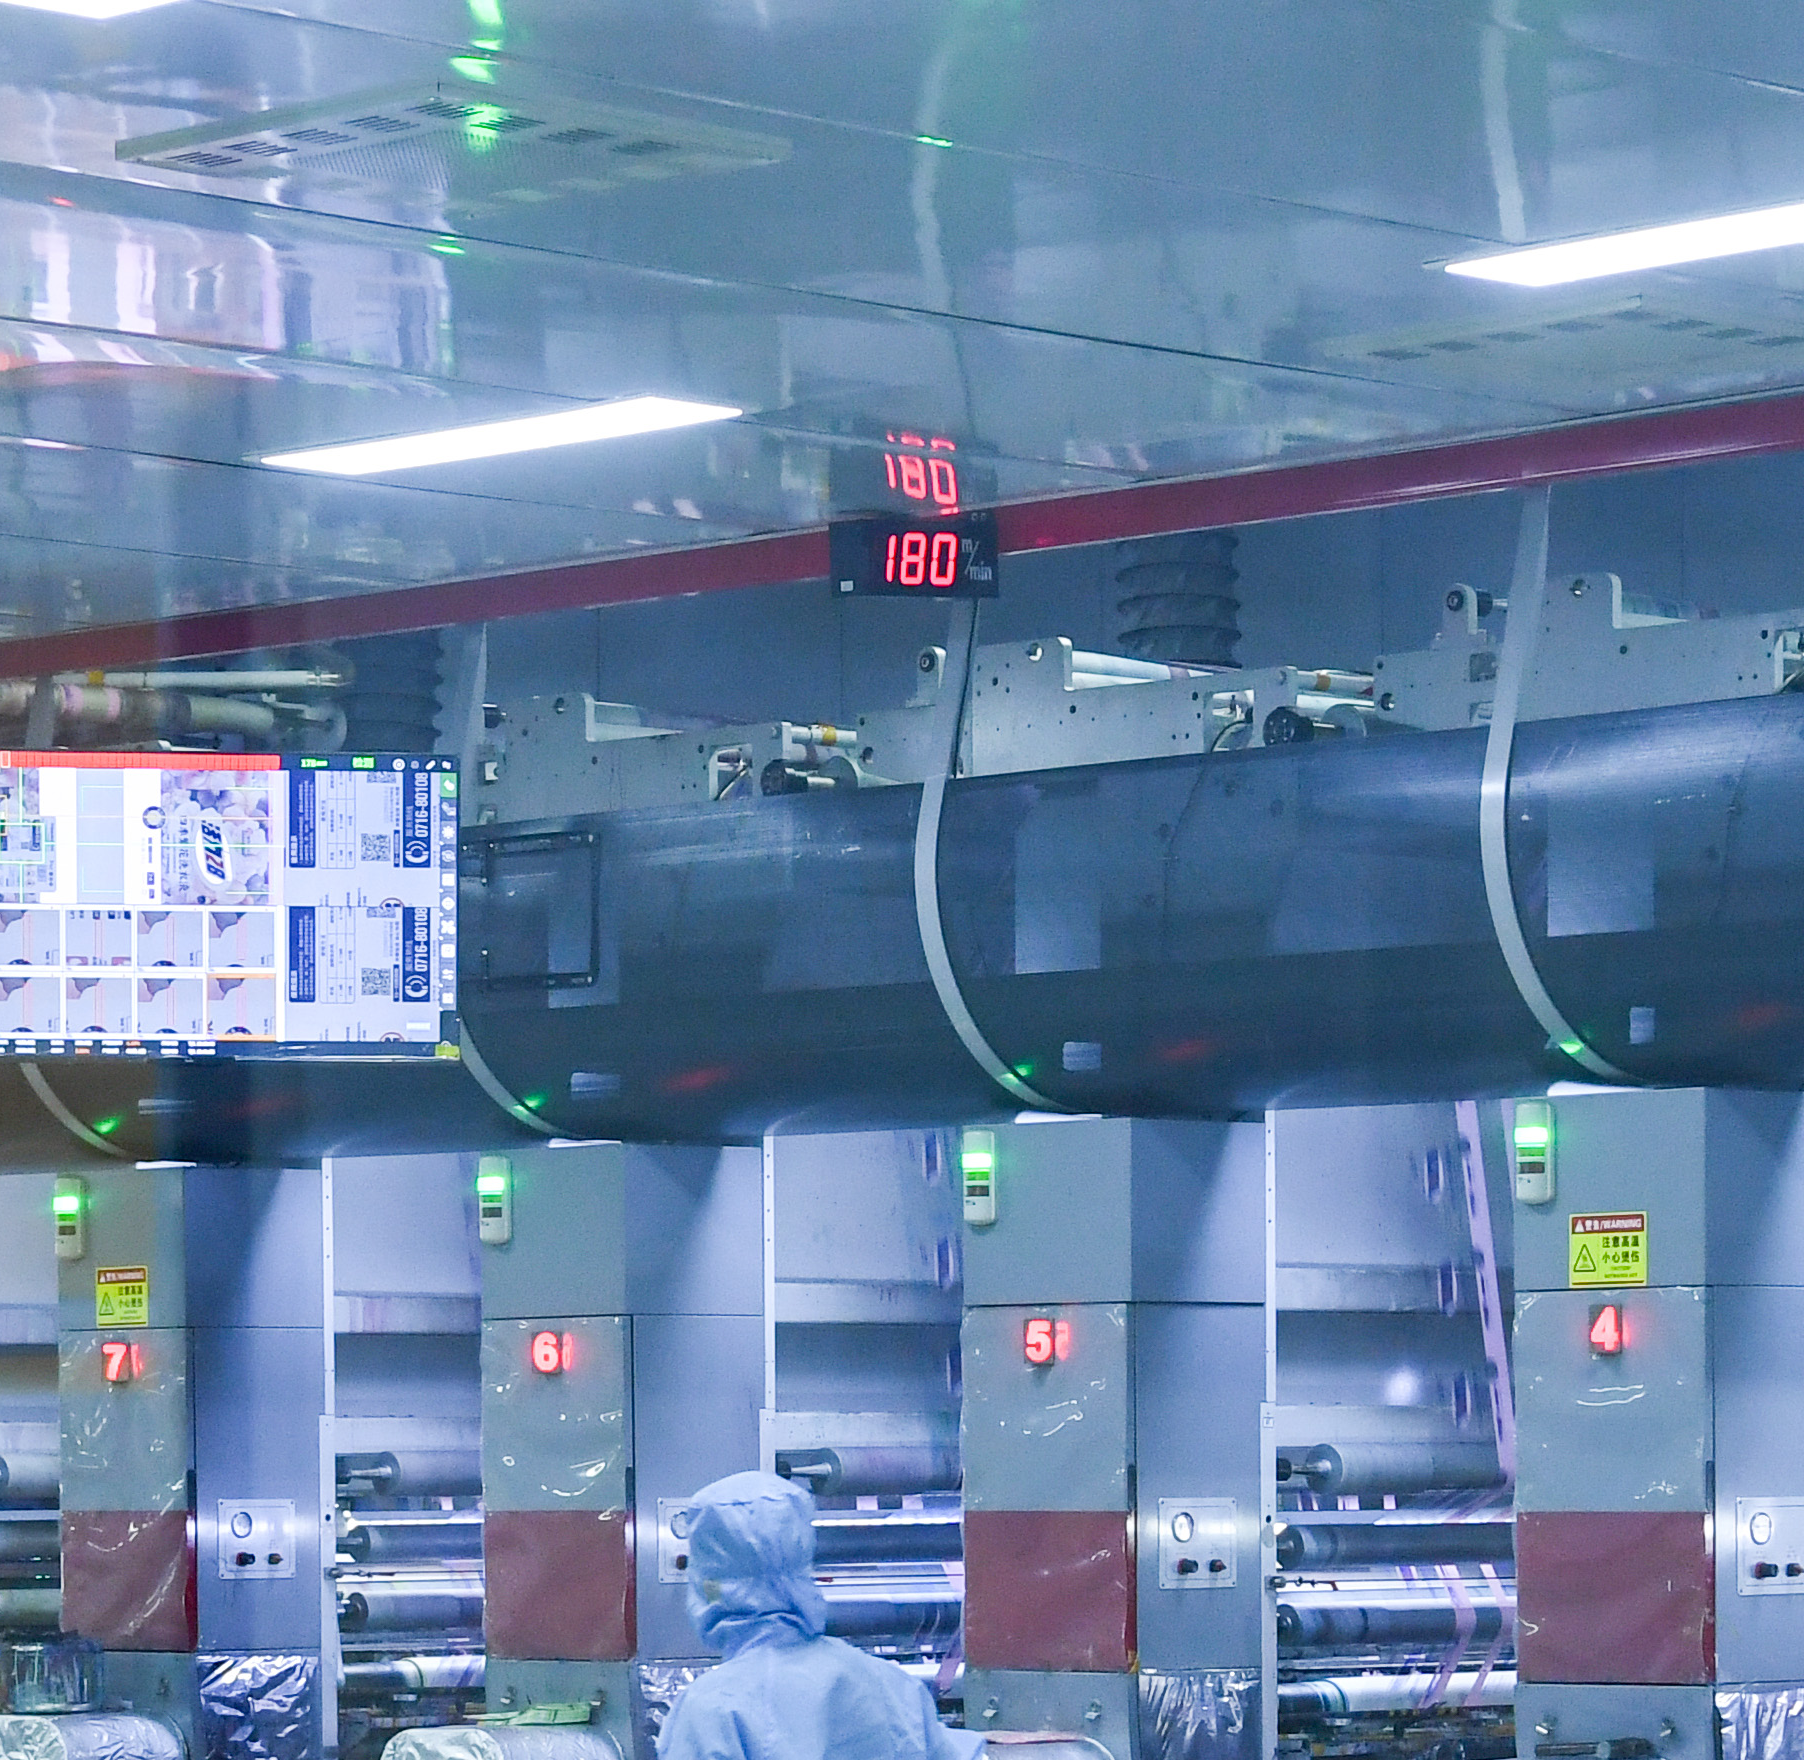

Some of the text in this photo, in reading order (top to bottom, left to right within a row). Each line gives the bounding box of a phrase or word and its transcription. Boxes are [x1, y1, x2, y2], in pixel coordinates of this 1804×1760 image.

[885, 531, 959, 587] 180
[1602, 1235, 1639, 1248] 注意高温
[1025, 1319, 1054, 1363] 5
[1590, 1306, 1621, 1352] 4
[102, 1342, 130, 1379] 7
[532, 1331, 560, 1373] 6
